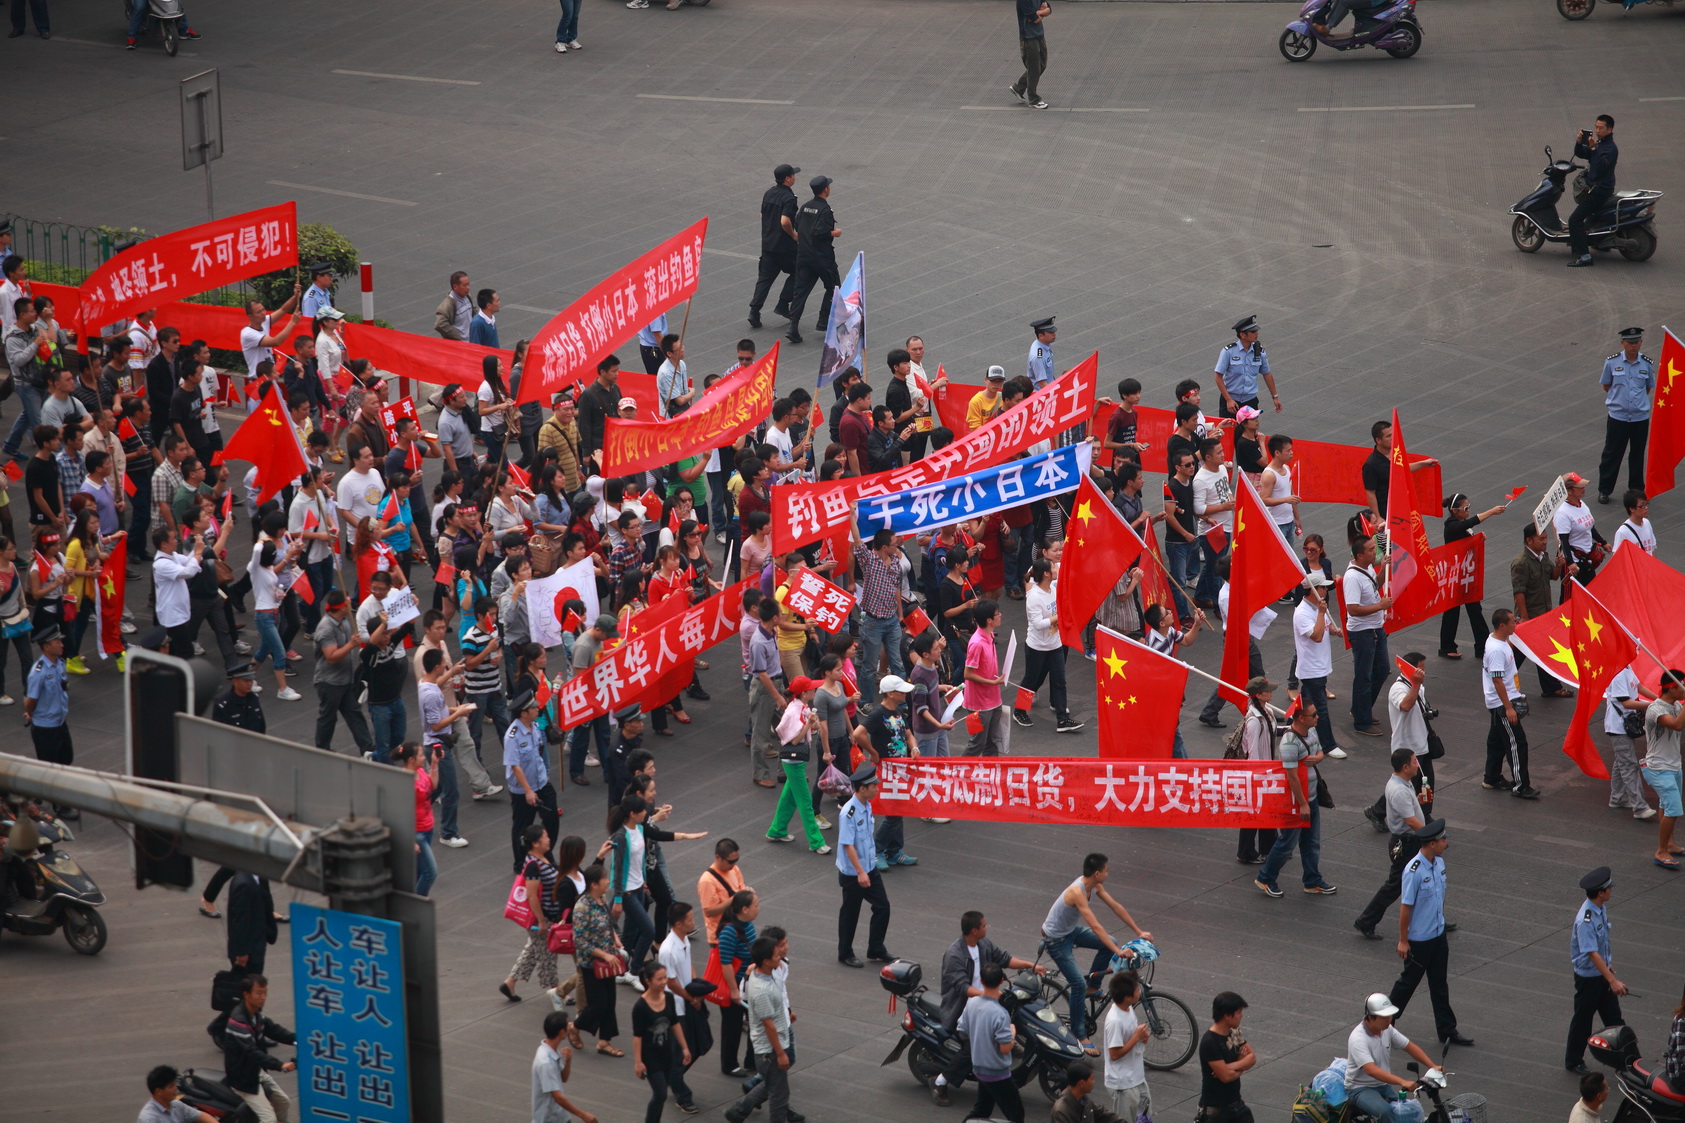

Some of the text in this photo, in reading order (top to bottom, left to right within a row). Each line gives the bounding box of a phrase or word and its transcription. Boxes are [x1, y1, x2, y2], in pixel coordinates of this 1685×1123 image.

[579, 278, 639, 354] 打倒小日本
[868, 452, 1069, 531] 干死小日本
[789, 590, 841, 631] 保钓
[800, 572, 852, 613] 誓死
[303, 917, 346, 1016] 人让车
[350, 924, 393, 1027] 车让人
